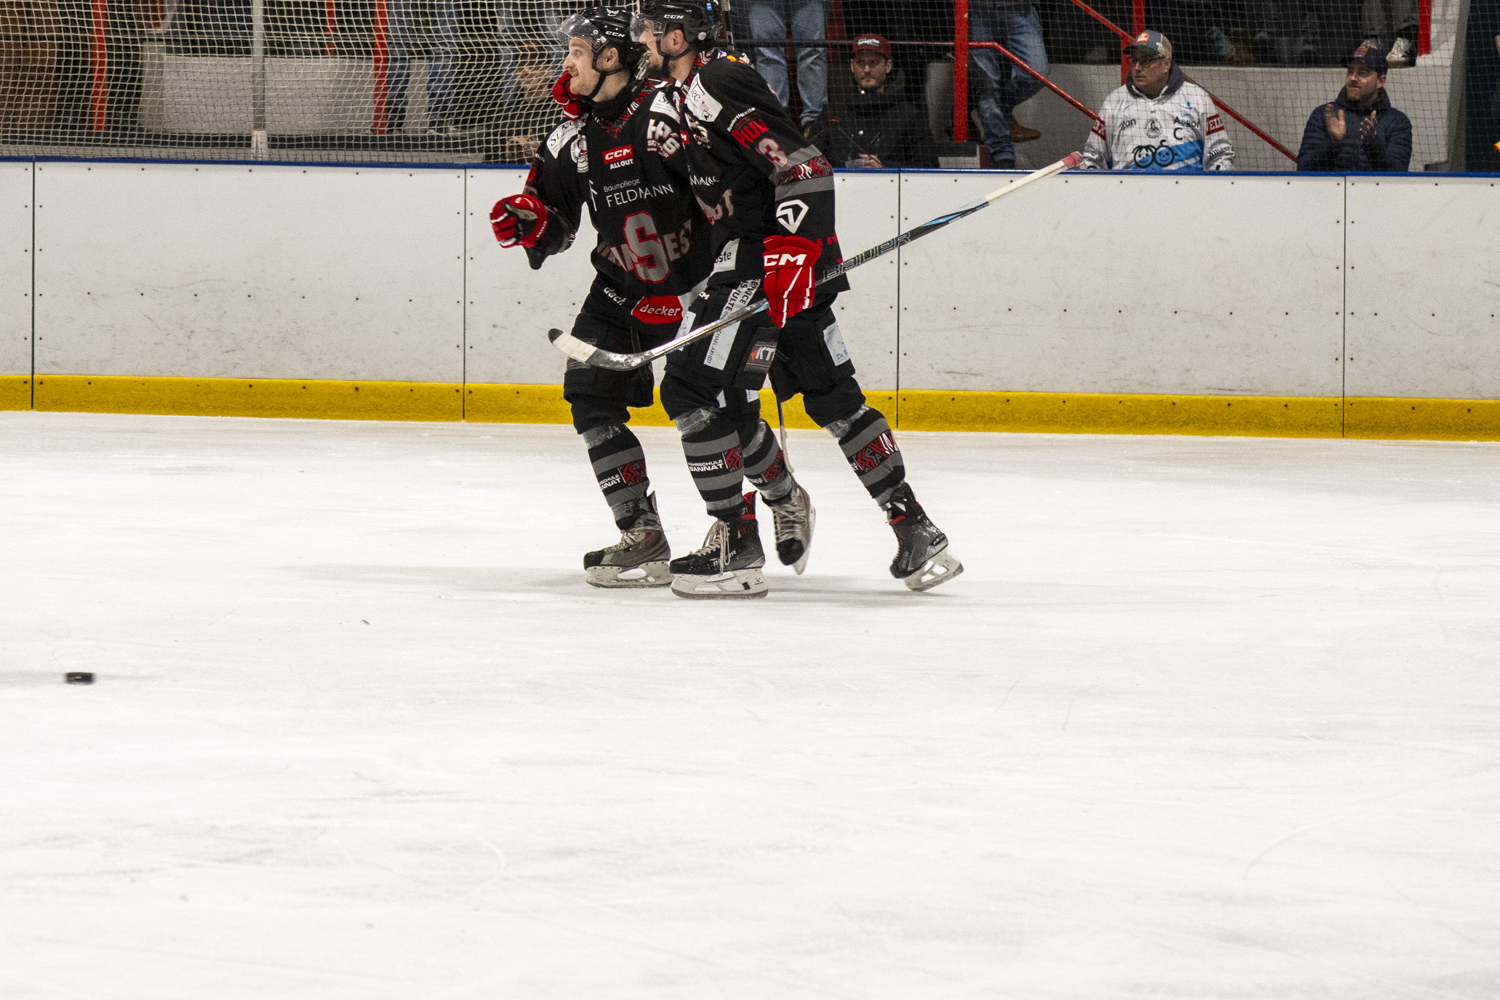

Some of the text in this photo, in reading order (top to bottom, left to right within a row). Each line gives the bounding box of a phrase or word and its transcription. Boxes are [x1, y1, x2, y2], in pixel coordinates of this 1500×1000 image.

[605, 30, 626, 38] CCM
[1173, 127, 1184, 141] C
[604, 148, 632, 161] CCM
[603, 178, 640, 193] Baumpflege
[606, 183, 674, 208] FELDMANN
[823, 231, 912, 283] BAUER
[603, 286, 628, 306] dach
[640, 303, 681, 318] decker
[712, 329, 723, 348] CHAEL
